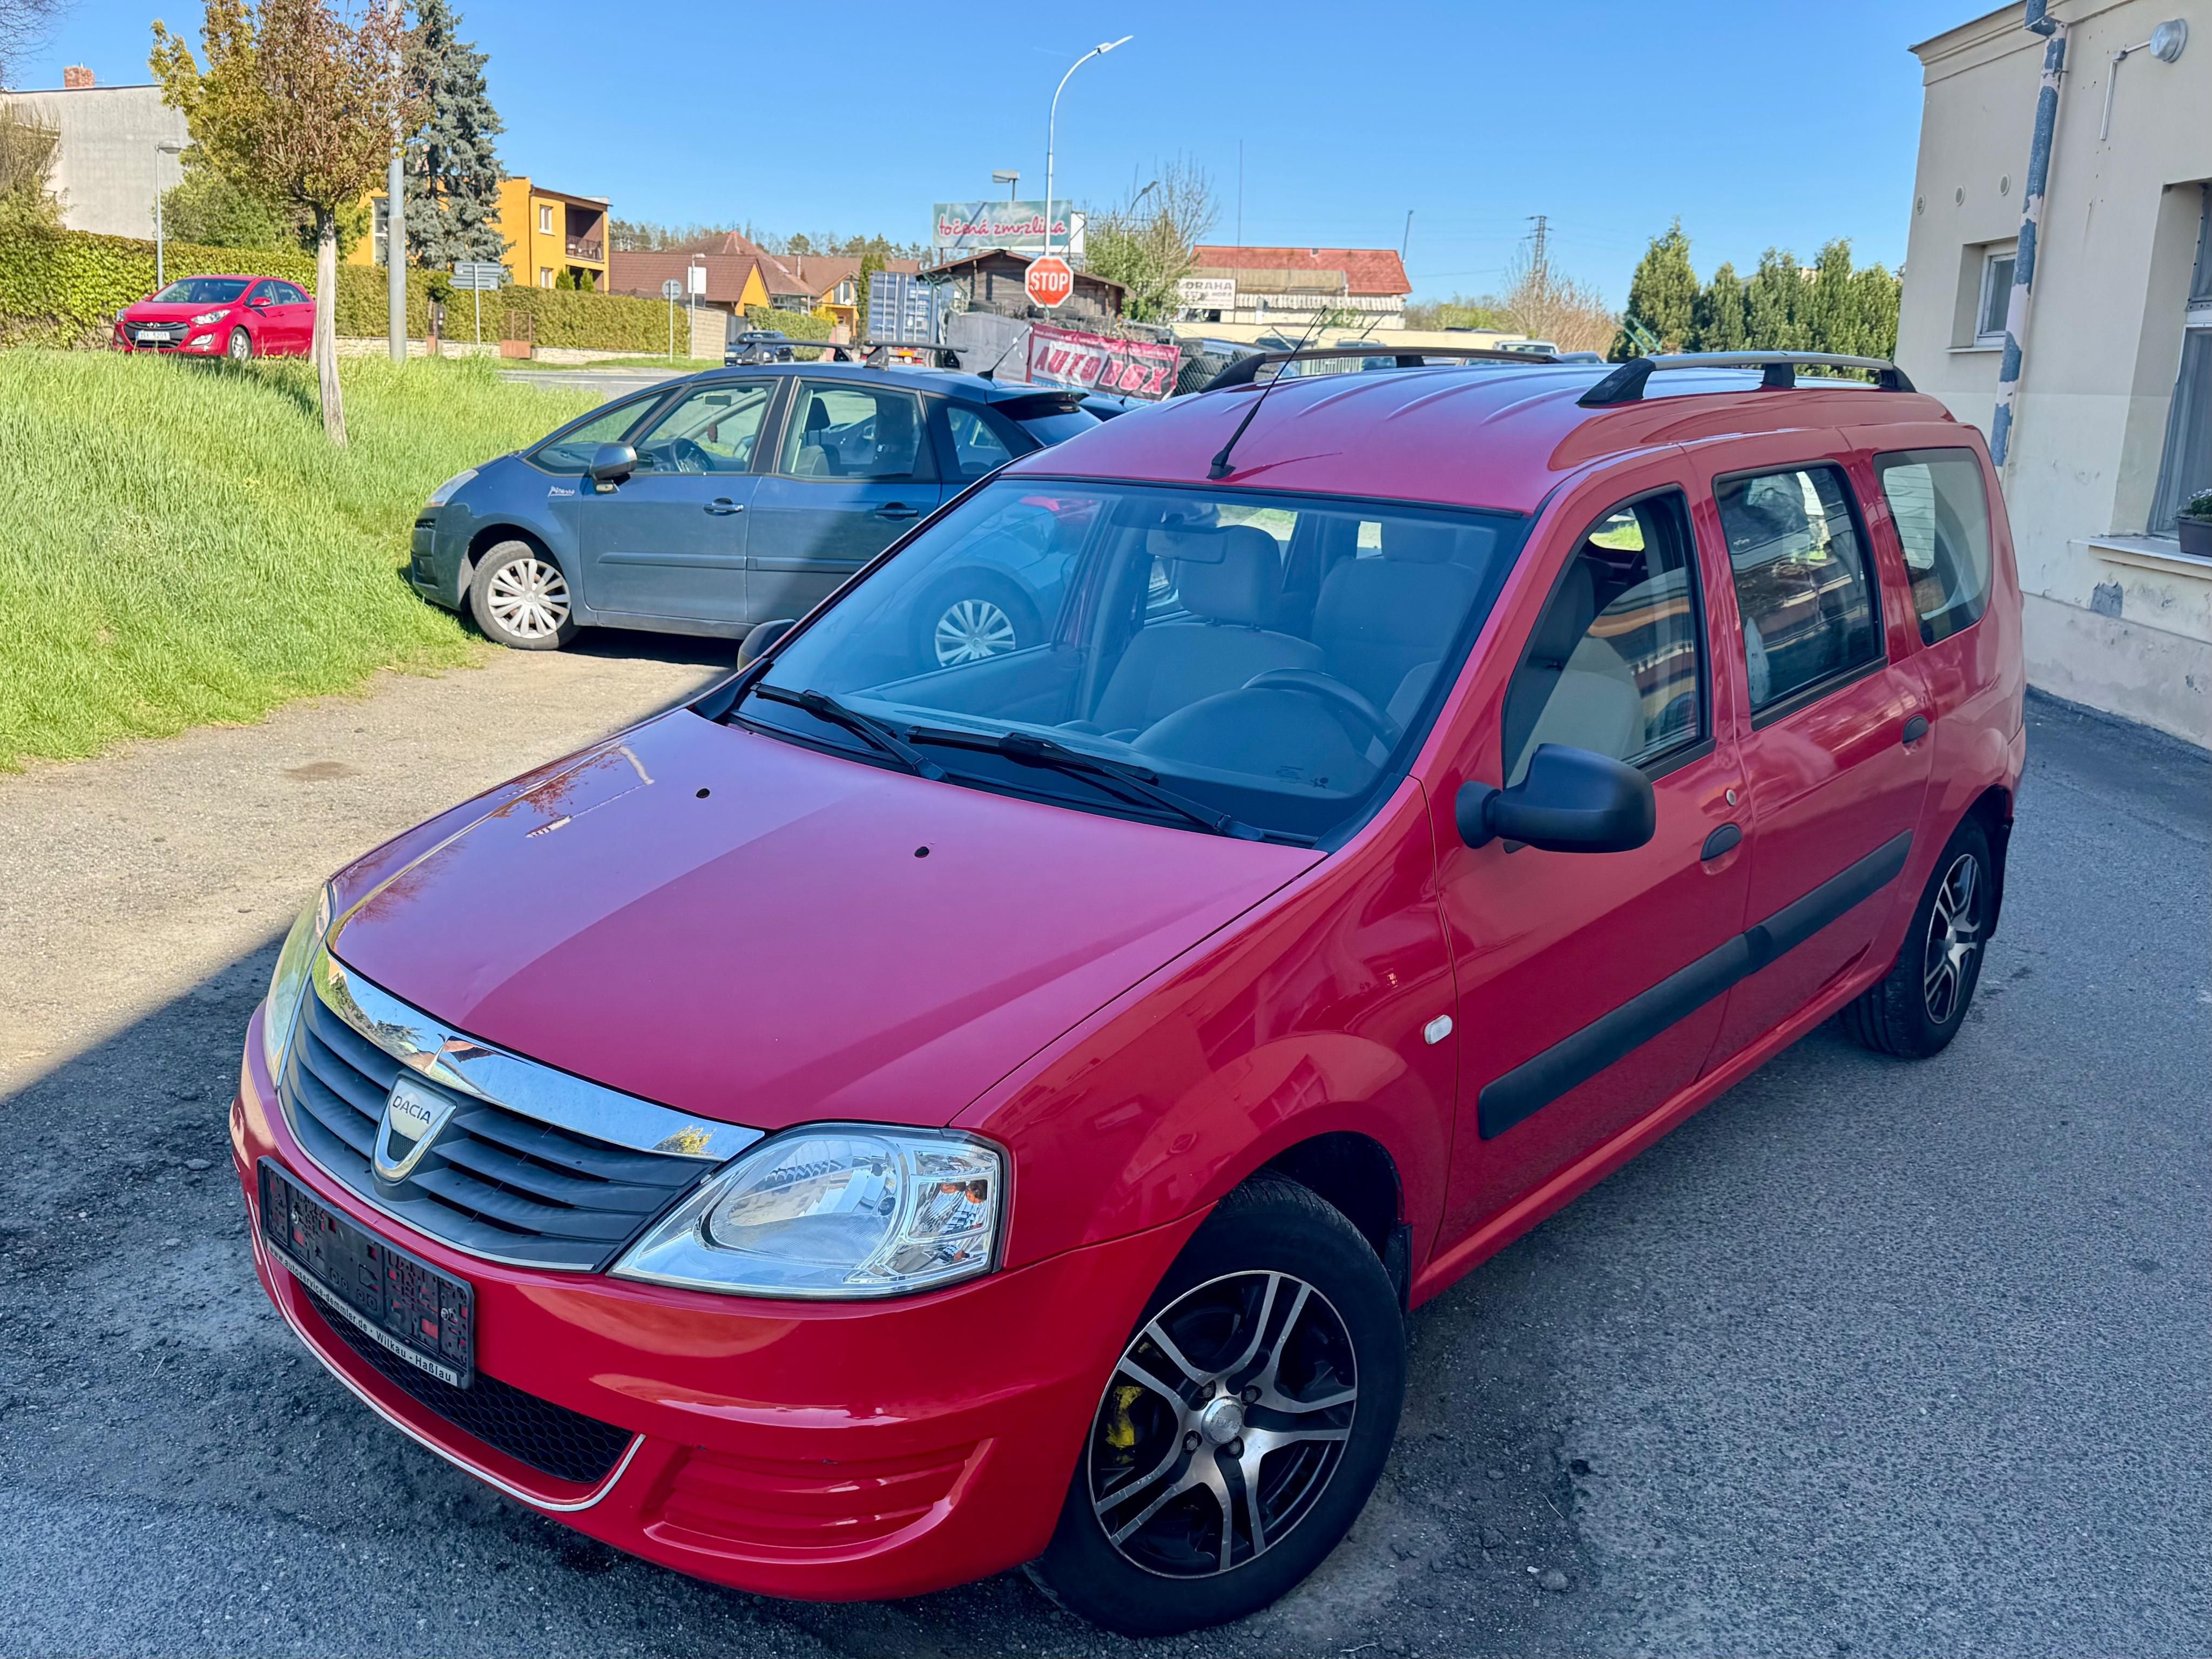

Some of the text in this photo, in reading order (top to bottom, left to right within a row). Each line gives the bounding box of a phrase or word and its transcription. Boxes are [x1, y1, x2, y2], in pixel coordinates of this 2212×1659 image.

[939, 214, 1067, 235] točená zmrzlia
[1030, 271, 1069, 292] STOP
[1034, 346, 1171, 395] AUTO BOX
[392, 1095, 431, 1124] DACIA
[270, 1246, 367, 1332] www.autoservice-demmler.de
[376, 1330, 406, 1358] Wilkau
[415, 1355, 451, 1382] Haßlau
